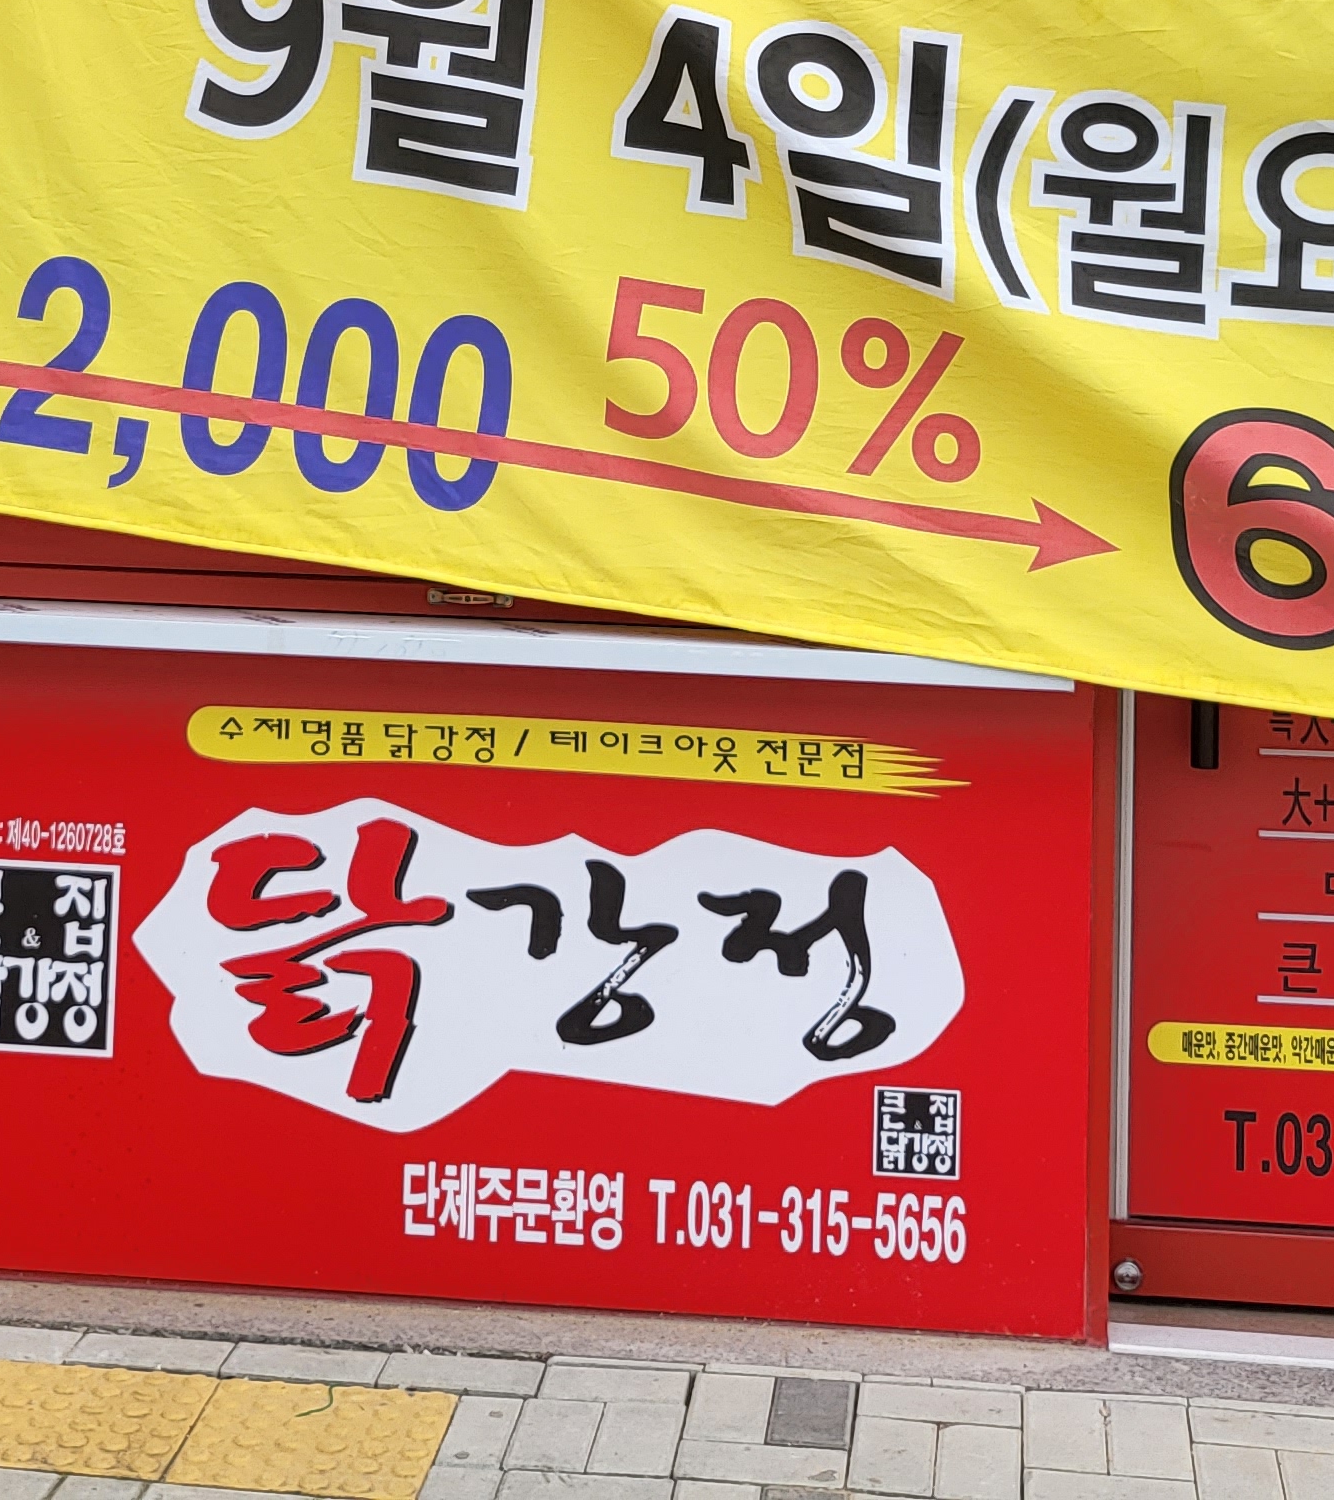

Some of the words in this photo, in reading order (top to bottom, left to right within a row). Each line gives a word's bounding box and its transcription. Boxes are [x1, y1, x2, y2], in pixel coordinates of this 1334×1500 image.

[603, 275, 981, 484] 50%
[383, 722, 497, 763] 닭강정
[549, 730, 738, 774] 테이크아웃
[756, 738, 865, 781] 전문점
[207, 817, 895, 1102] 닭강정
[1278, 942, 1322, 994] 큰
[402, 1161, 624, 1251] 단체주문환영
[649, 1179, 967, 1264] T.031-315-5656
